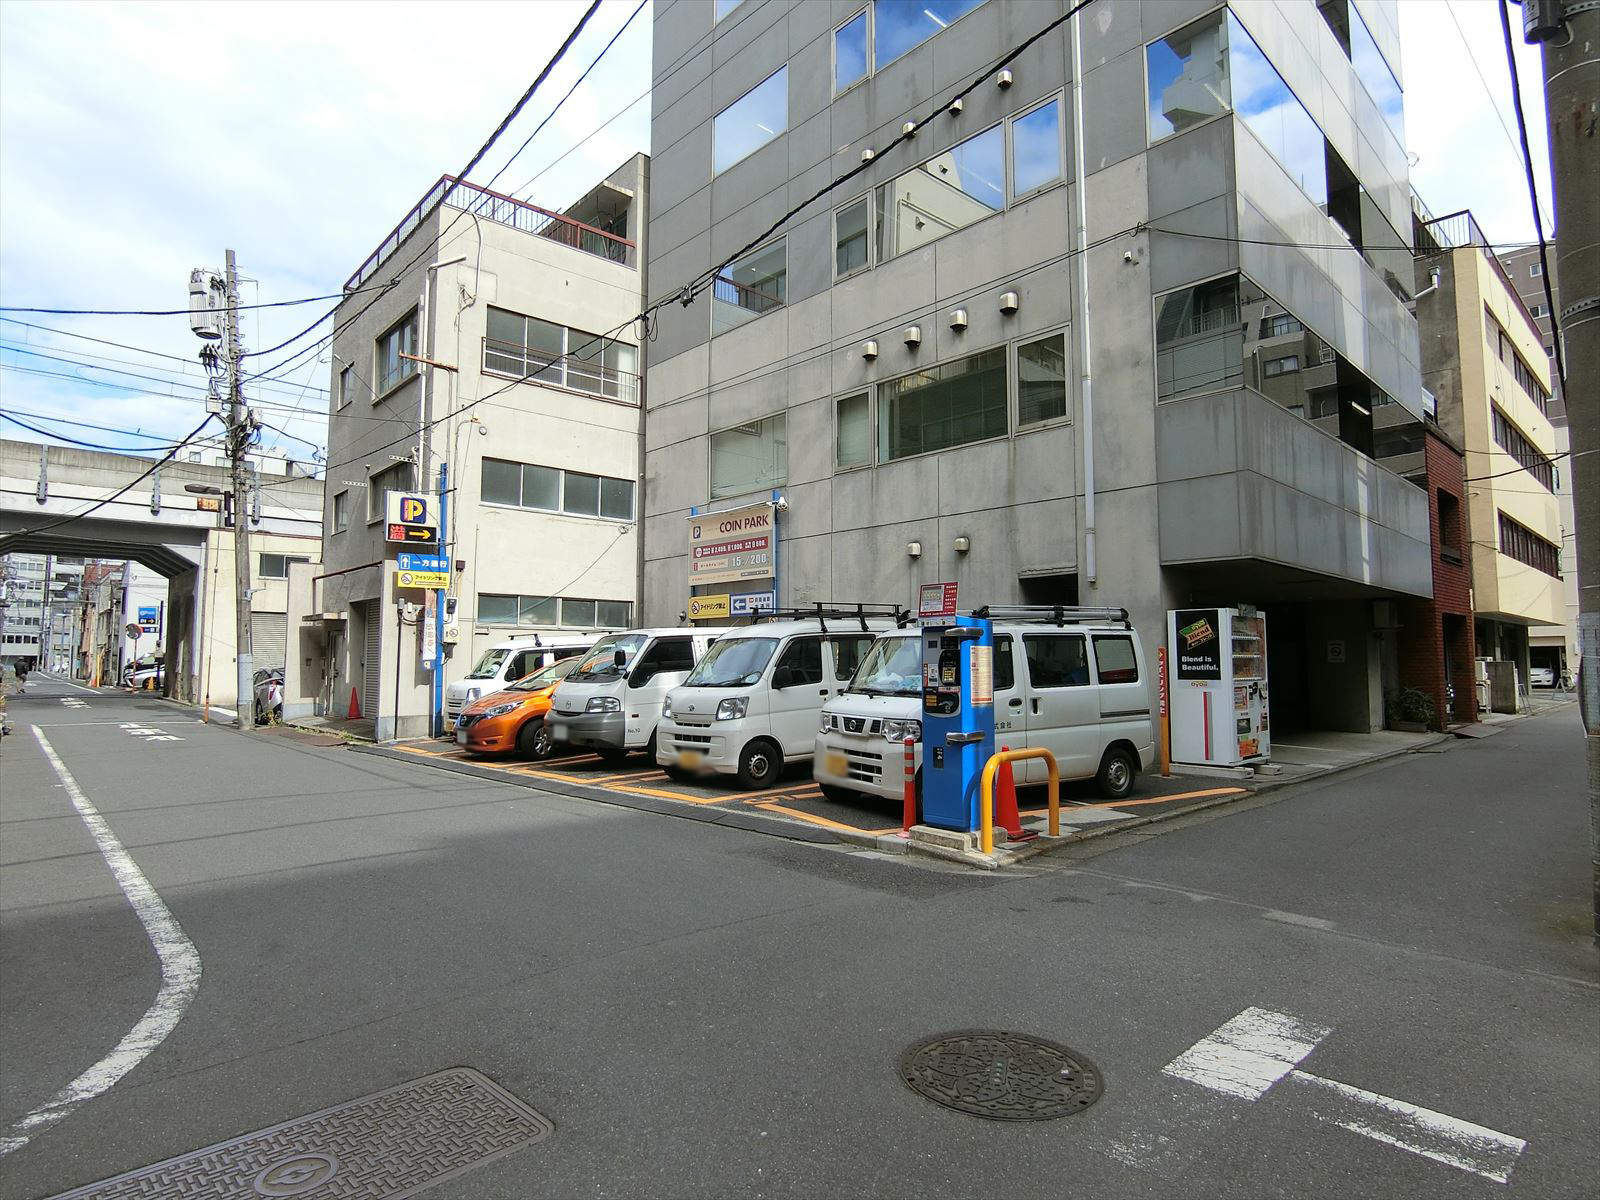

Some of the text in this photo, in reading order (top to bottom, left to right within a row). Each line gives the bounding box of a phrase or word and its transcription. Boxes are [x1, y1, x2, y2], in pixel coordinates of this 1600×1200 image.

[404, 499, 423, 521] P
[719, 514, 769, 533] COIN PARK
[693, 527, 700, 538] P
[412, 559, 447, 568] 一方通行
[732, 556, 741, 567] 15
[750, 553, 767, 565] 200
[1188, 626, 1210, 641] Blend
